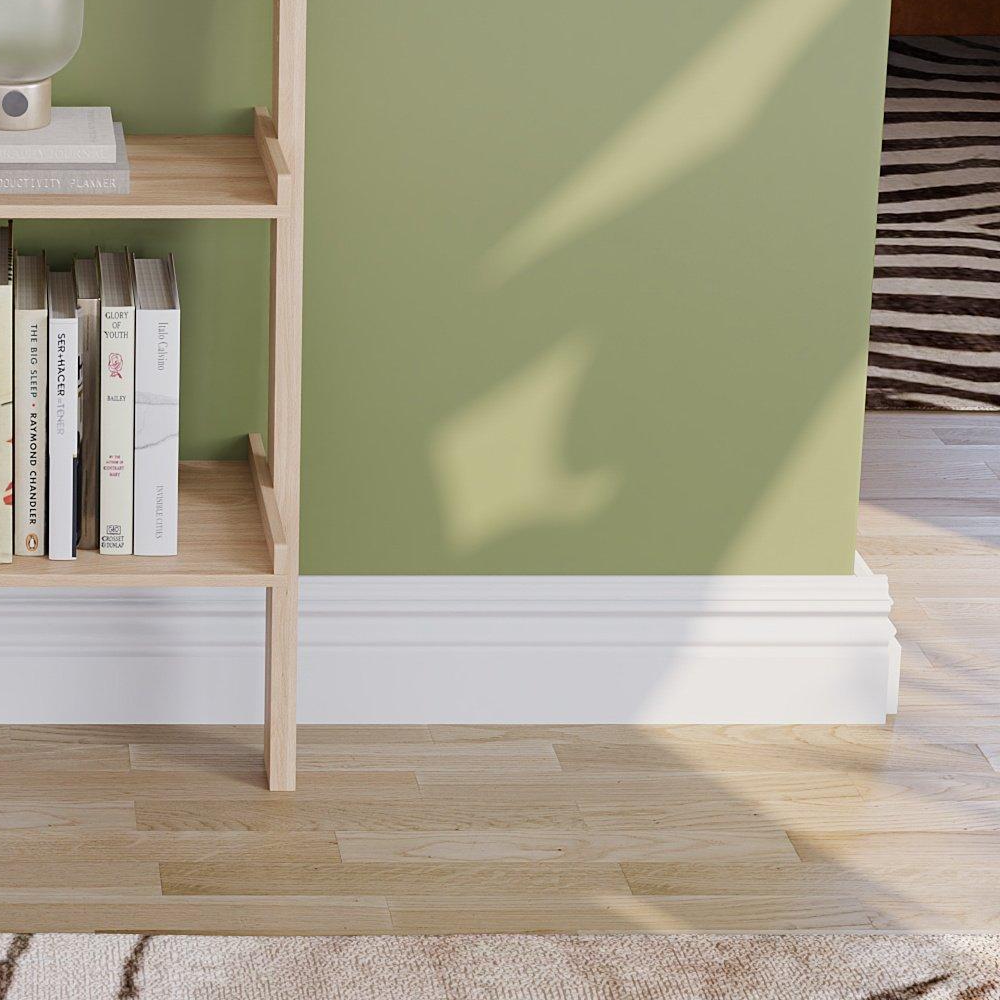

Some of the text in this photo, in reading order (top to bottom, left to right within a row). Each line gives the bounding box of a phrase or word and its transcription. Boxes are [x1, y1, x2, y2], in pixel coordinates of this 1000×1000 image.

[69, 177, 117, 188] PLANNER
[104, 311, 129, 320] GLORY
[111, 321, 122, 329] OF
[104, 331, 129, 339] YOUTH
[157, 321, 169, 371] Italo Calvino
[28, 324, 38, 525] THE BIG SLEEP RAYMOND CHANDLER
